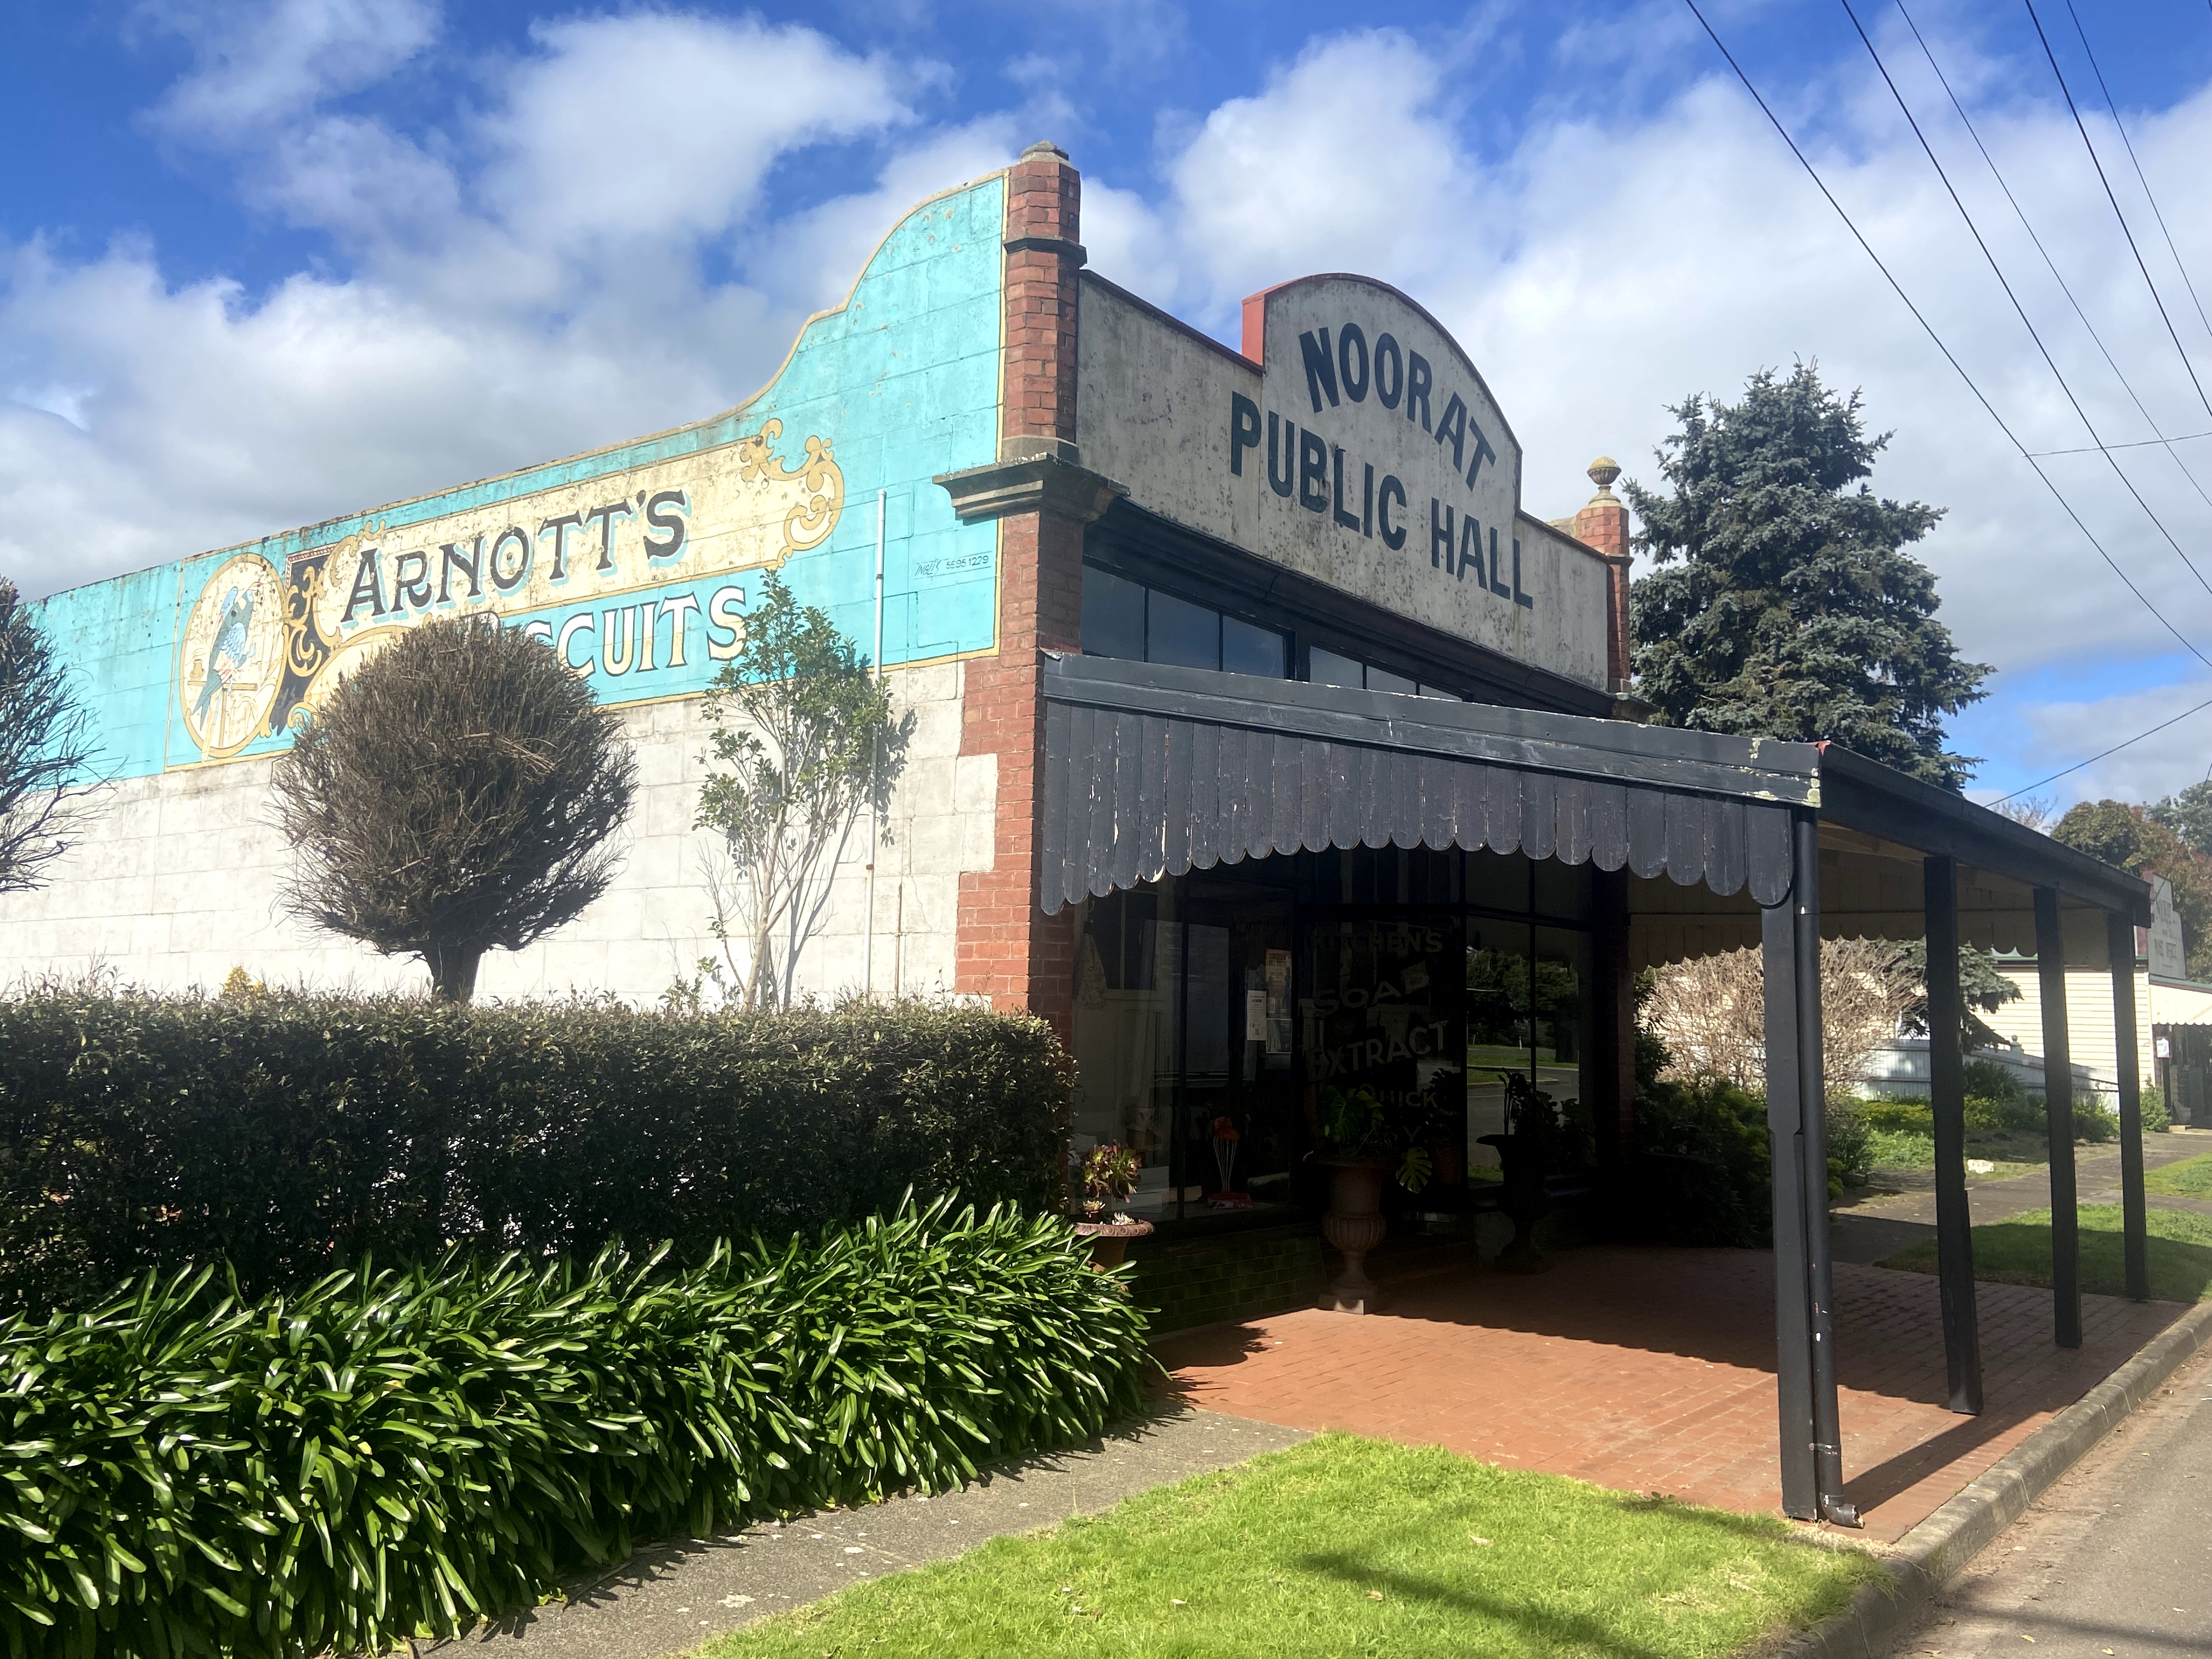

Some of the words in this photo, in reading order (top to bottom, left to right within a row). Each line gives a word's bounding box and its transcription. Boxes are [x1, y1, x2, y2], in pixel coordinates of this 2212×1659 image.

[1299, 323, 1496, 492] NOORAT
[340, 489, 686, 623] ARNOTT'S
[1231, 391, 1407, 551] PUBLIC
[1431, 497, 1533, 610] HALL
[460, 585, 747, 678] CUITS
[1307, 1019, 1449, 1082] EXTRACT
